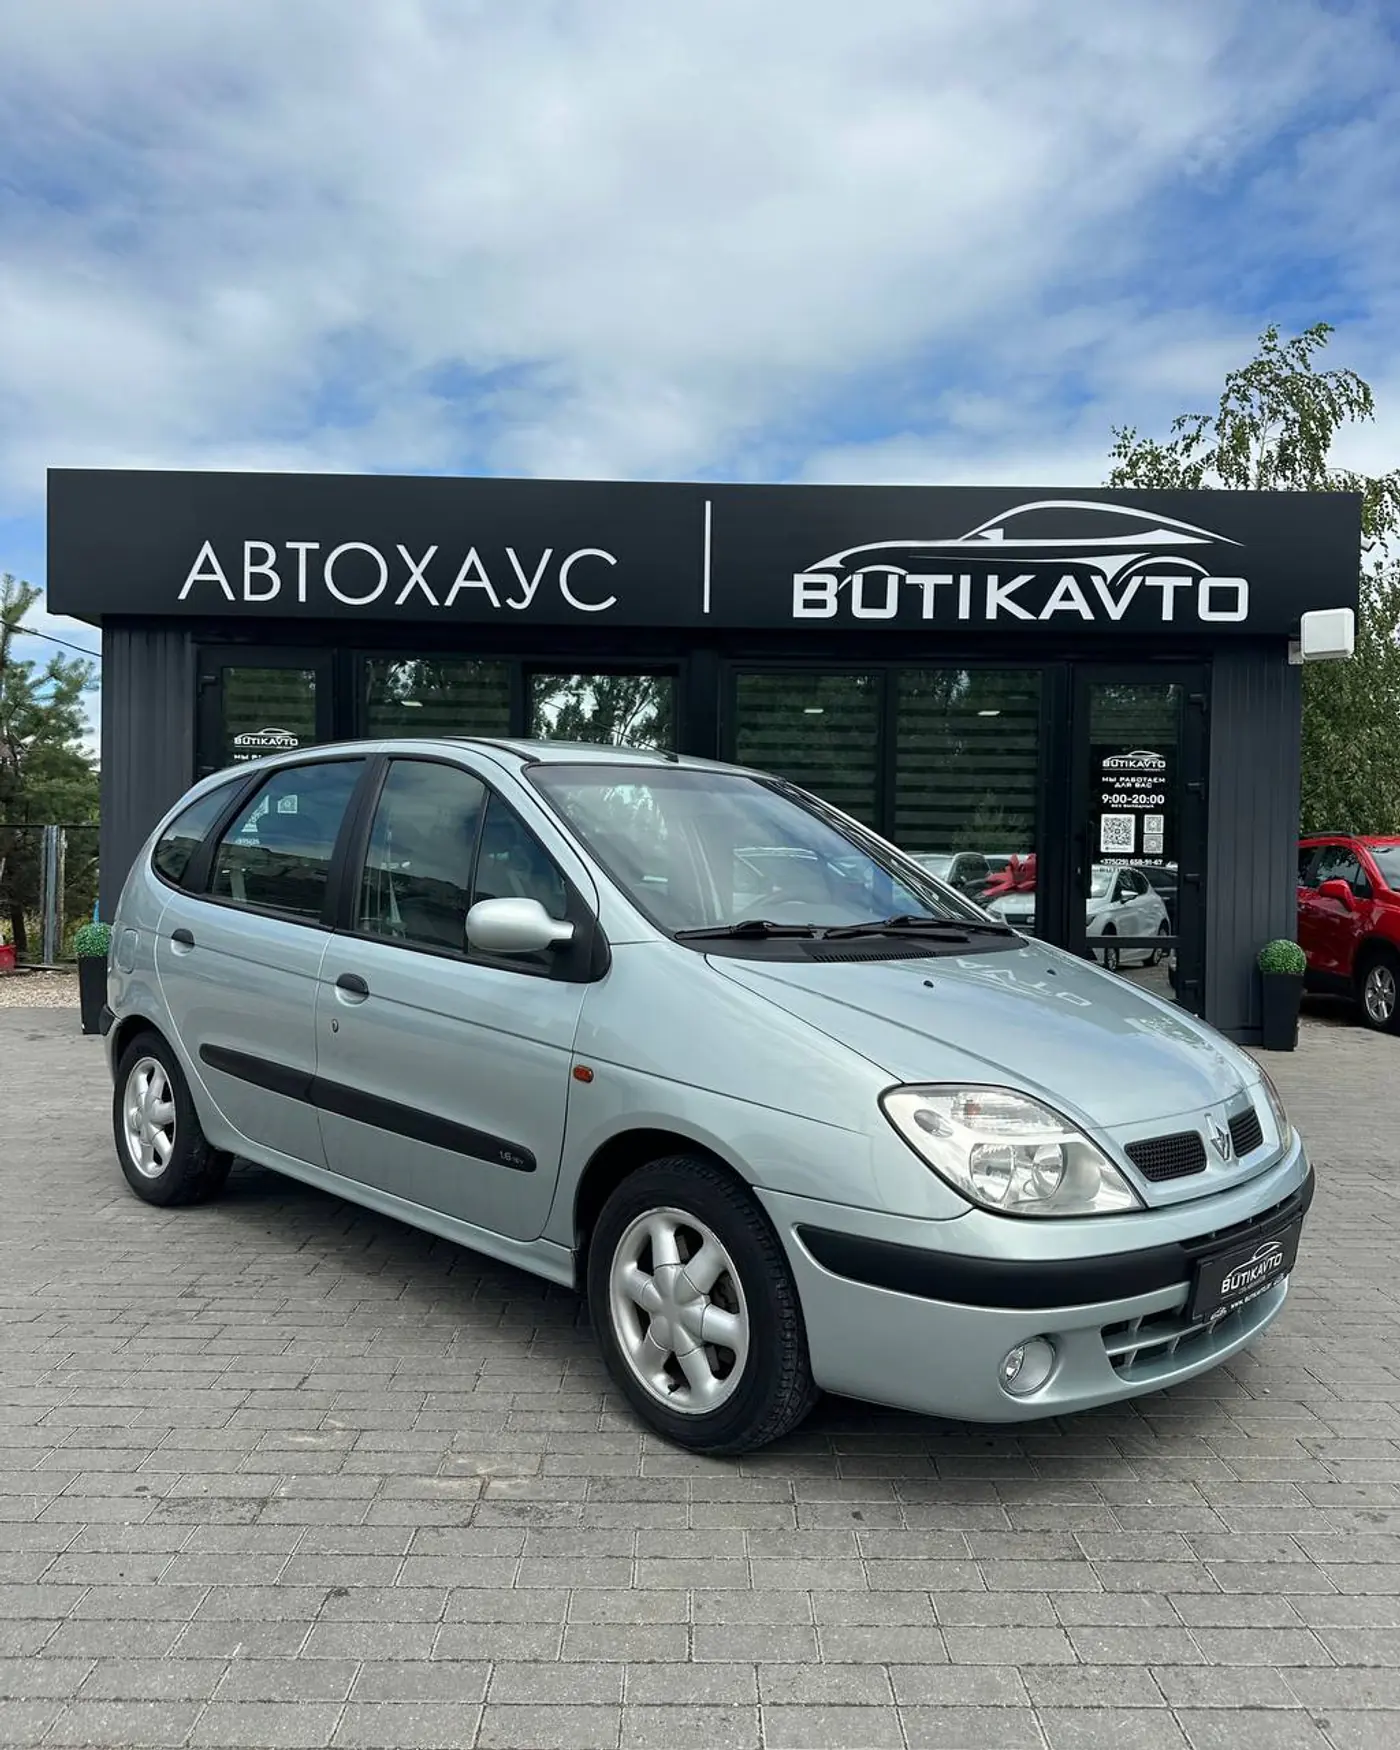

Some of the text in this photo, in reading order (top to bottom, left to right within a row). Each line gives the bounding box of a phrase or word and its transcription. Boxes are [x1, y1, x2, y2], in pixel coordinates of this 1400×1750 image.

[177, 539, 618, 612] АВТОХАУС
[792, 572, 1249, 622] BUTIKAVTO
[233, 737, 298, 746] BUTIKAVTO
[1102, 759, 1166, 768] BUTIKAVTO
[1101, 793, 1165, 804] 9:00-20:00
[1221, 1252, 1283, 1294] BUTIKAVTO
